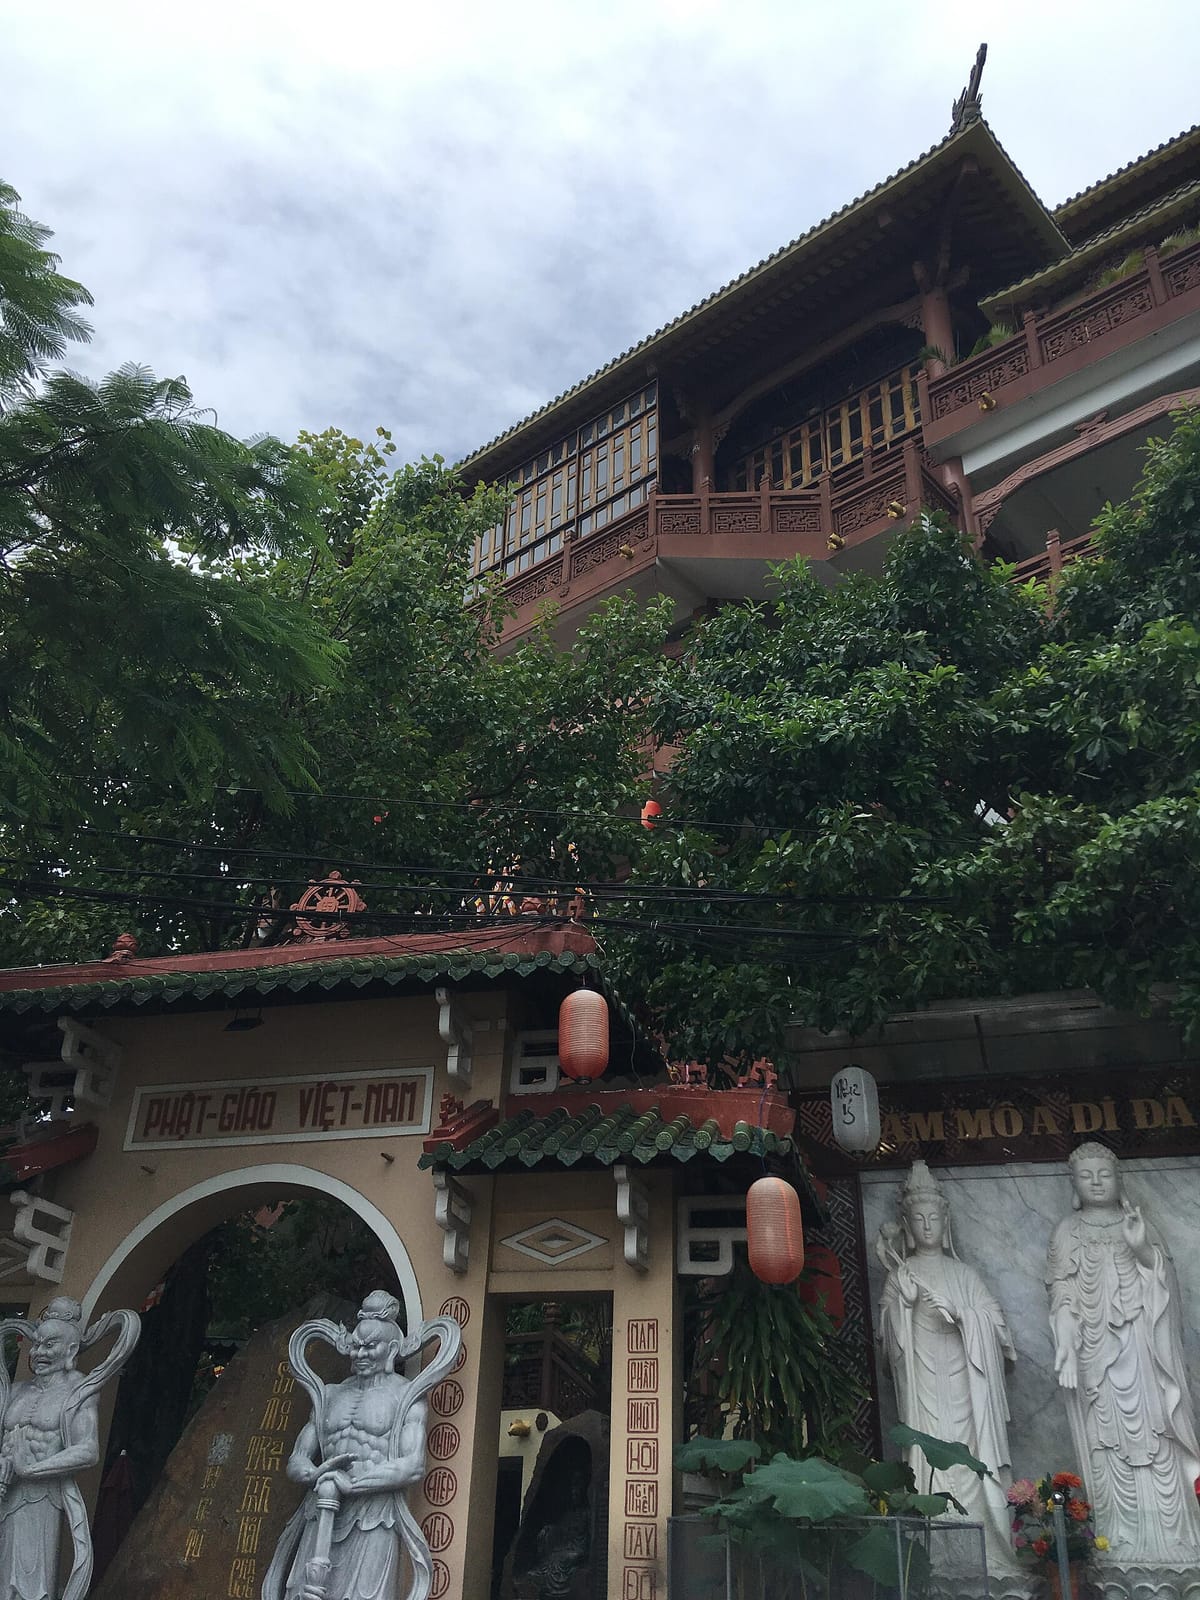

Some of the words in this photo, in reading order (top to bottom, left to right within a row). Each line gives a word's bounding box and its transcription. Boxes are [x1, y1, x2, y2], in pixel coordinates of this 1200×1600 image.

[881, 1111, 946, 1144] AM
[957, 1101, 1024, 1140] MÔ
[1031, 1105, 1063, 1136] A
[630, 1322, 656, 1351] NAM
